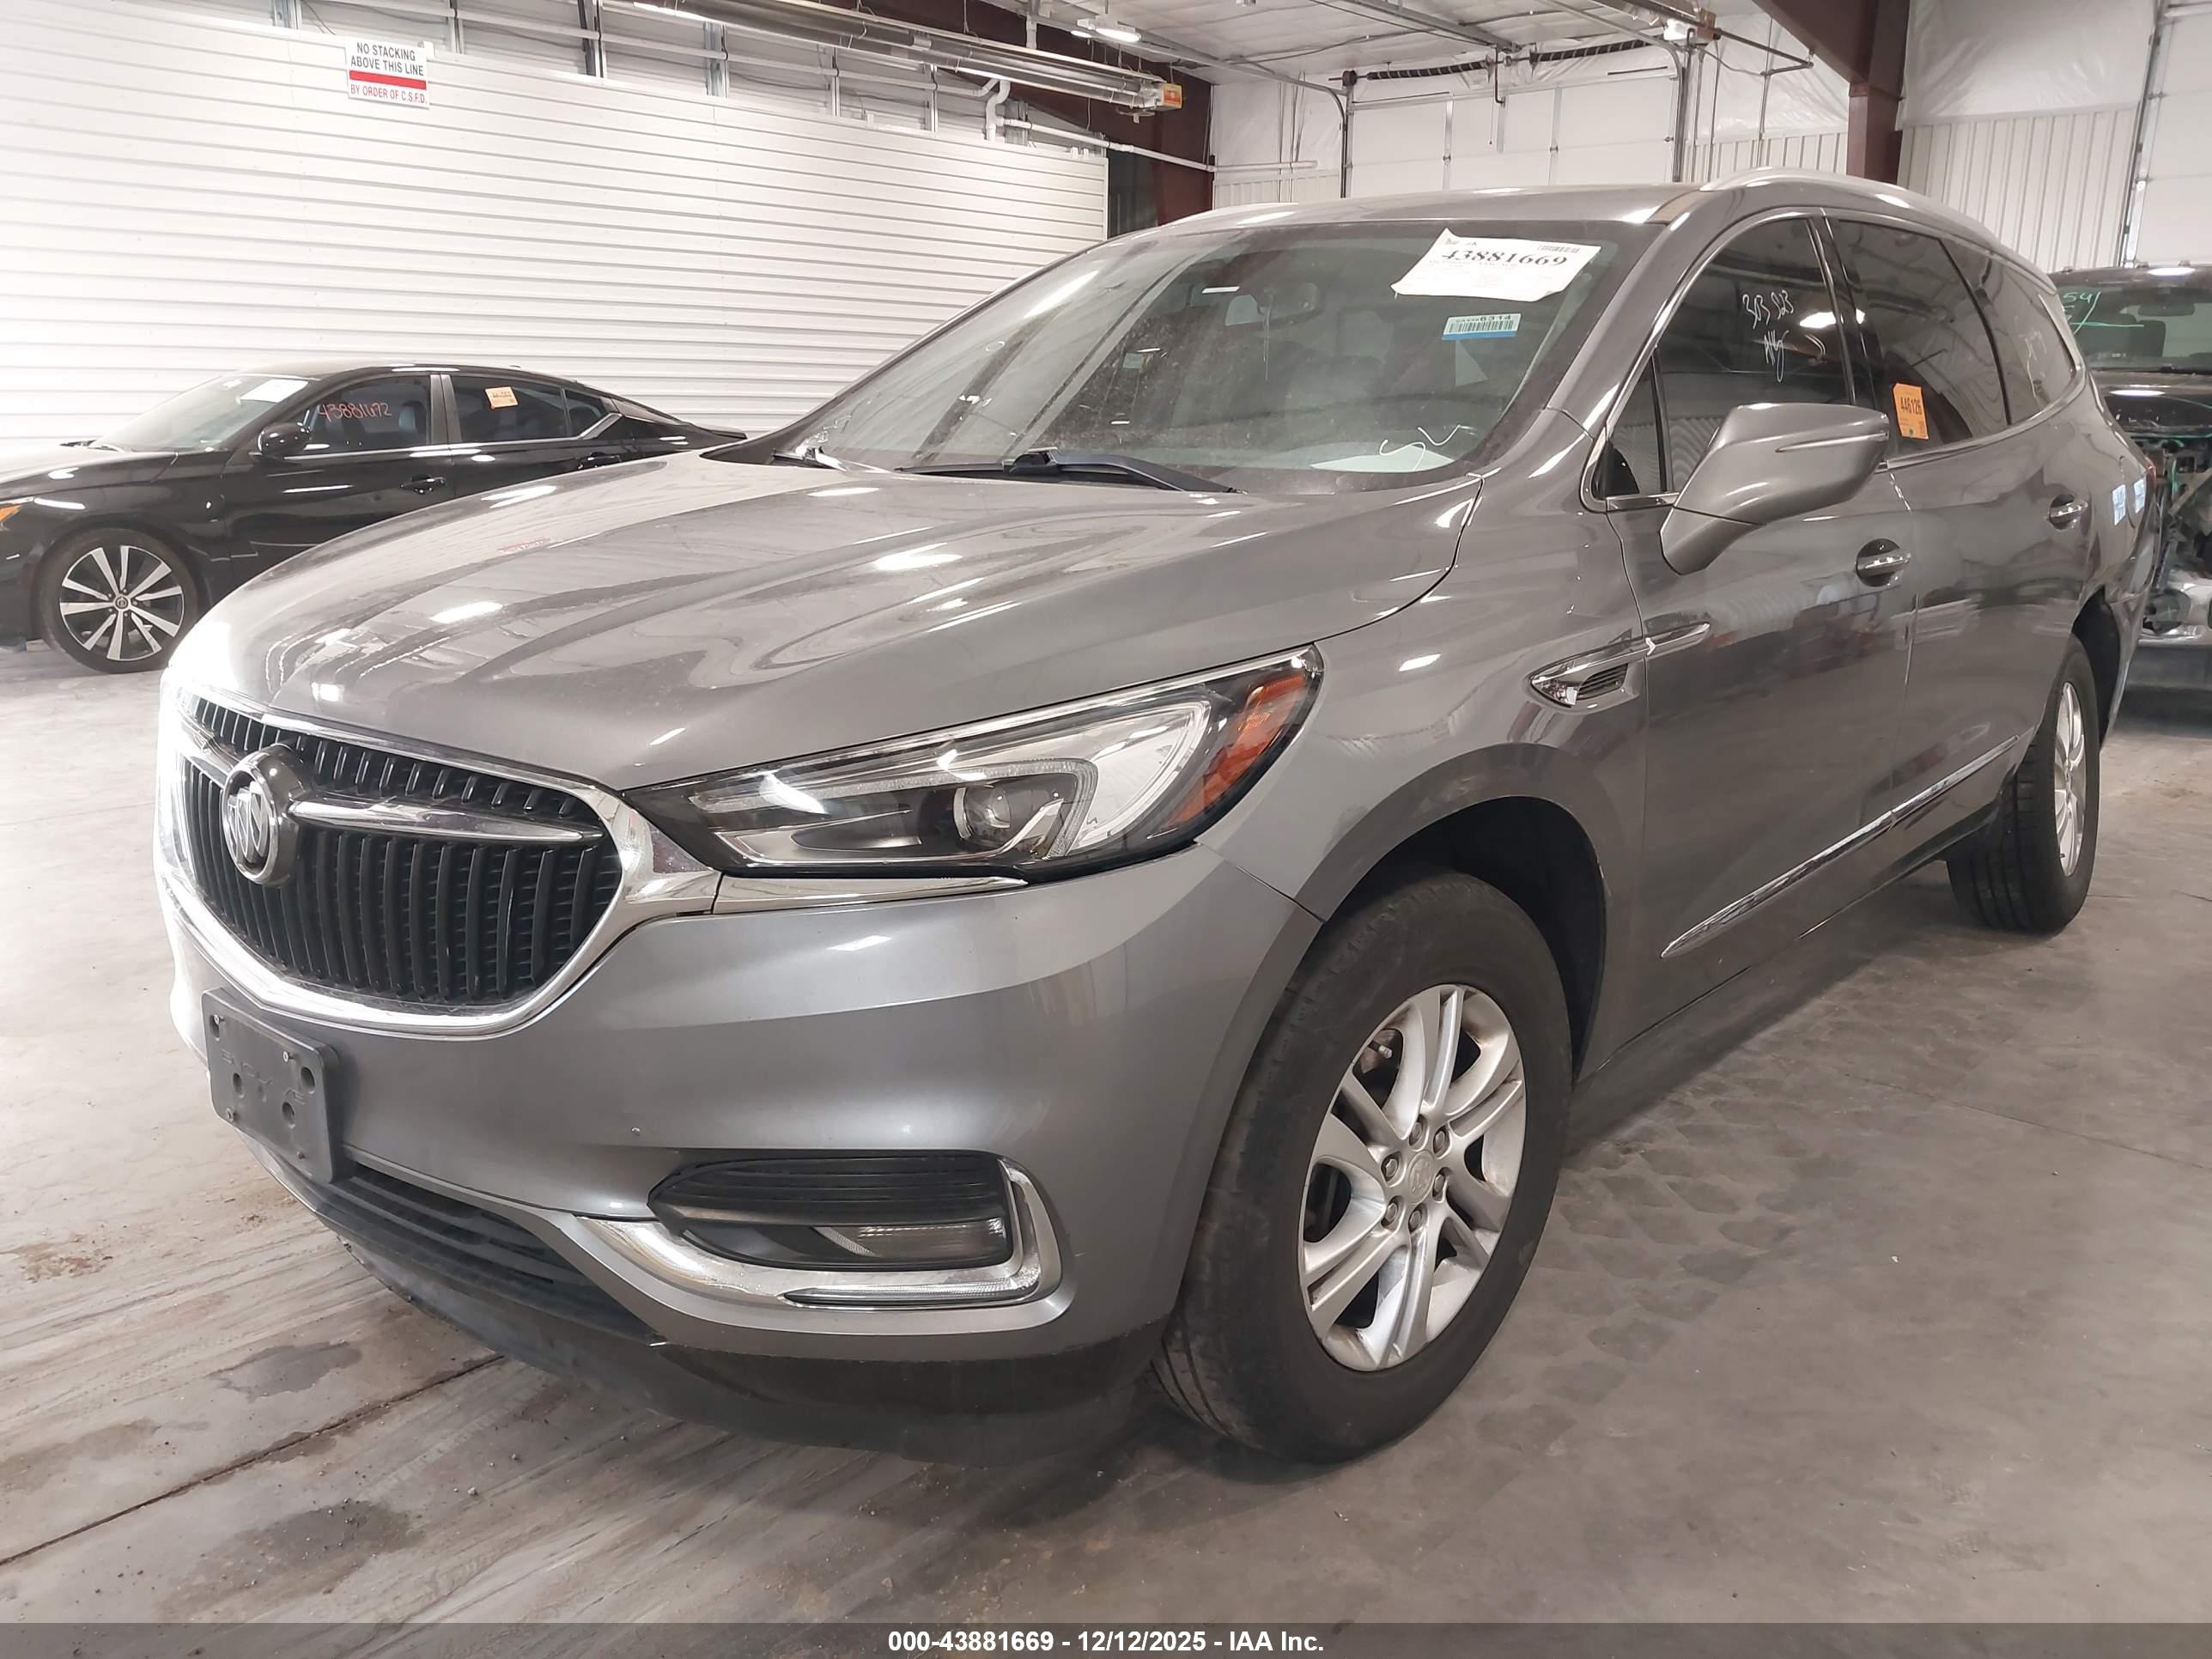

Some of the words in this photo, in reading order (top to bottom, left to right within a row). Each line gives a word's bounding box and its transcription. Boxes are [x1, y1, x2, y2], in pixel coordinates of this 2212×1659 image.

[356, 42, 369, 54] NO
[372, 45, 416, 61] STACKING
[350, 55, 380, 70] ABOVE
[383, 59, 403, 73] THIS
[404, 64, 424, 76] LINE
[350, 84, 360, 94] BY
[362, 86, 388, 99] ORDER
[390, 89, 398, 100] OF
[1442, 250, 1567, 265] 43881669
